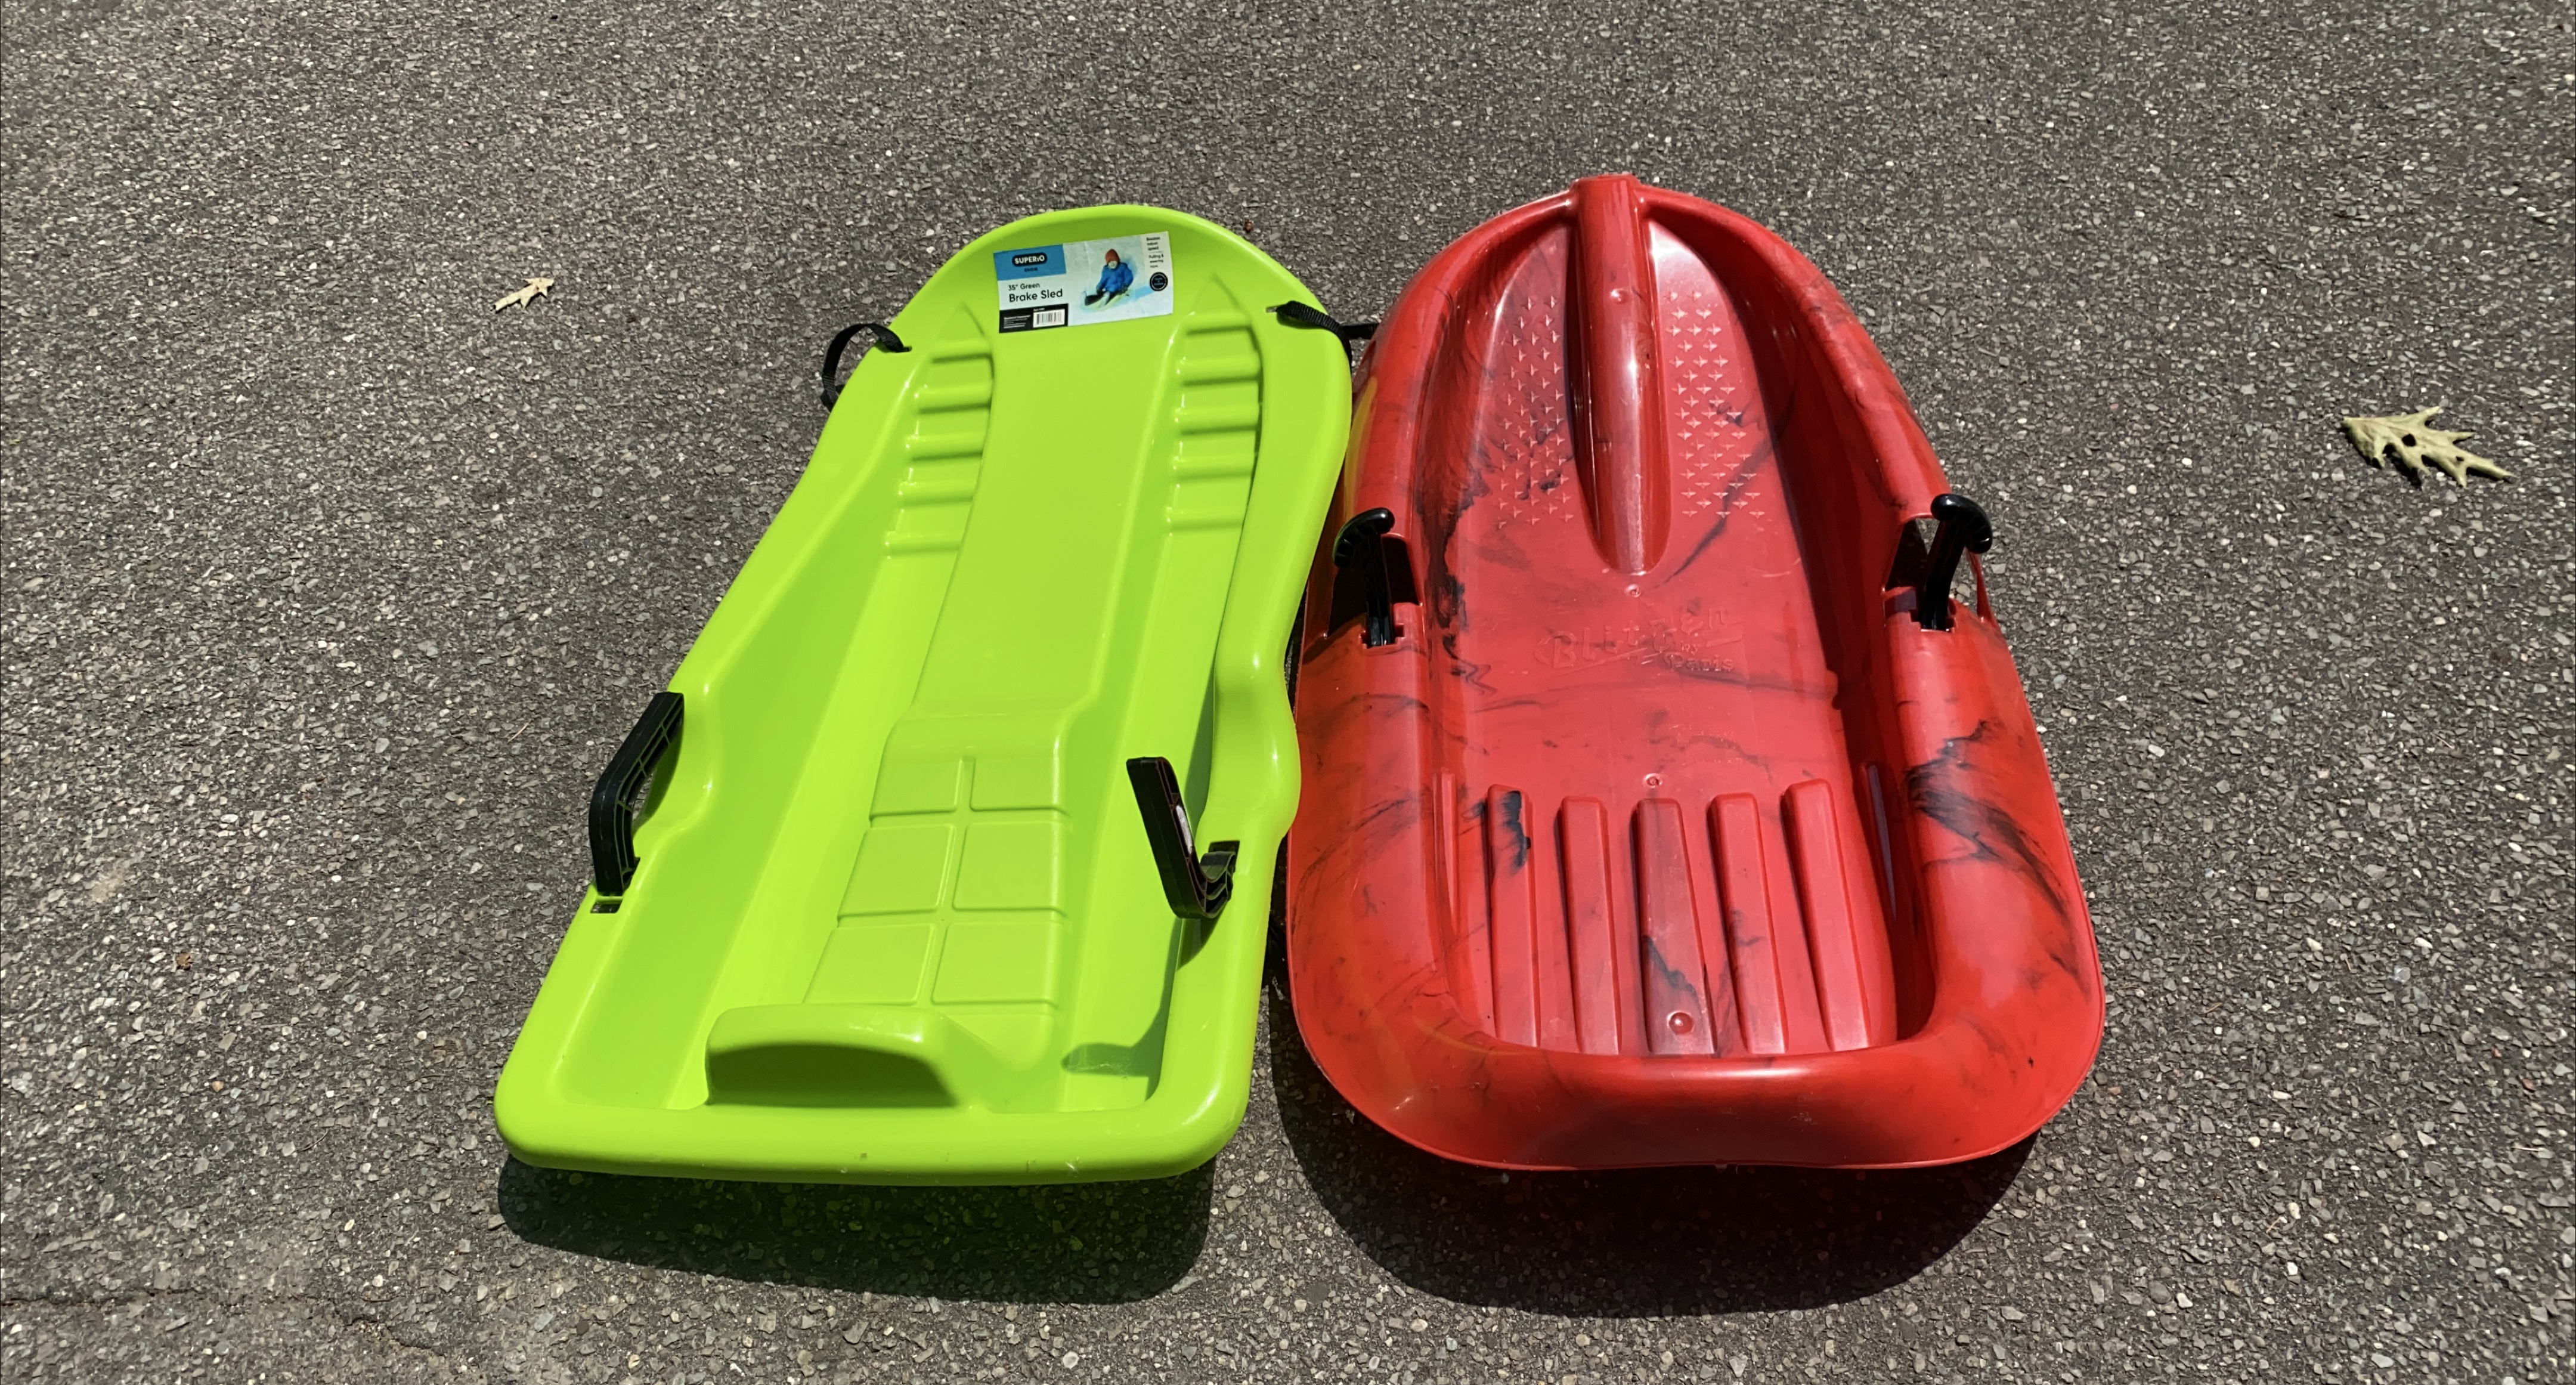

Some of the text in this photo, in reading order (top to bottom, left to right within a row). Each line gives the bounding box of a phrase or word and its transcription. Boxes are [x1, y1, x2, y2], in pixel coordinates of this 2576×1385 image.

[1009, 288, 1063, 303] Brake Sled
[1662, 651, 1735, 673] Paris
